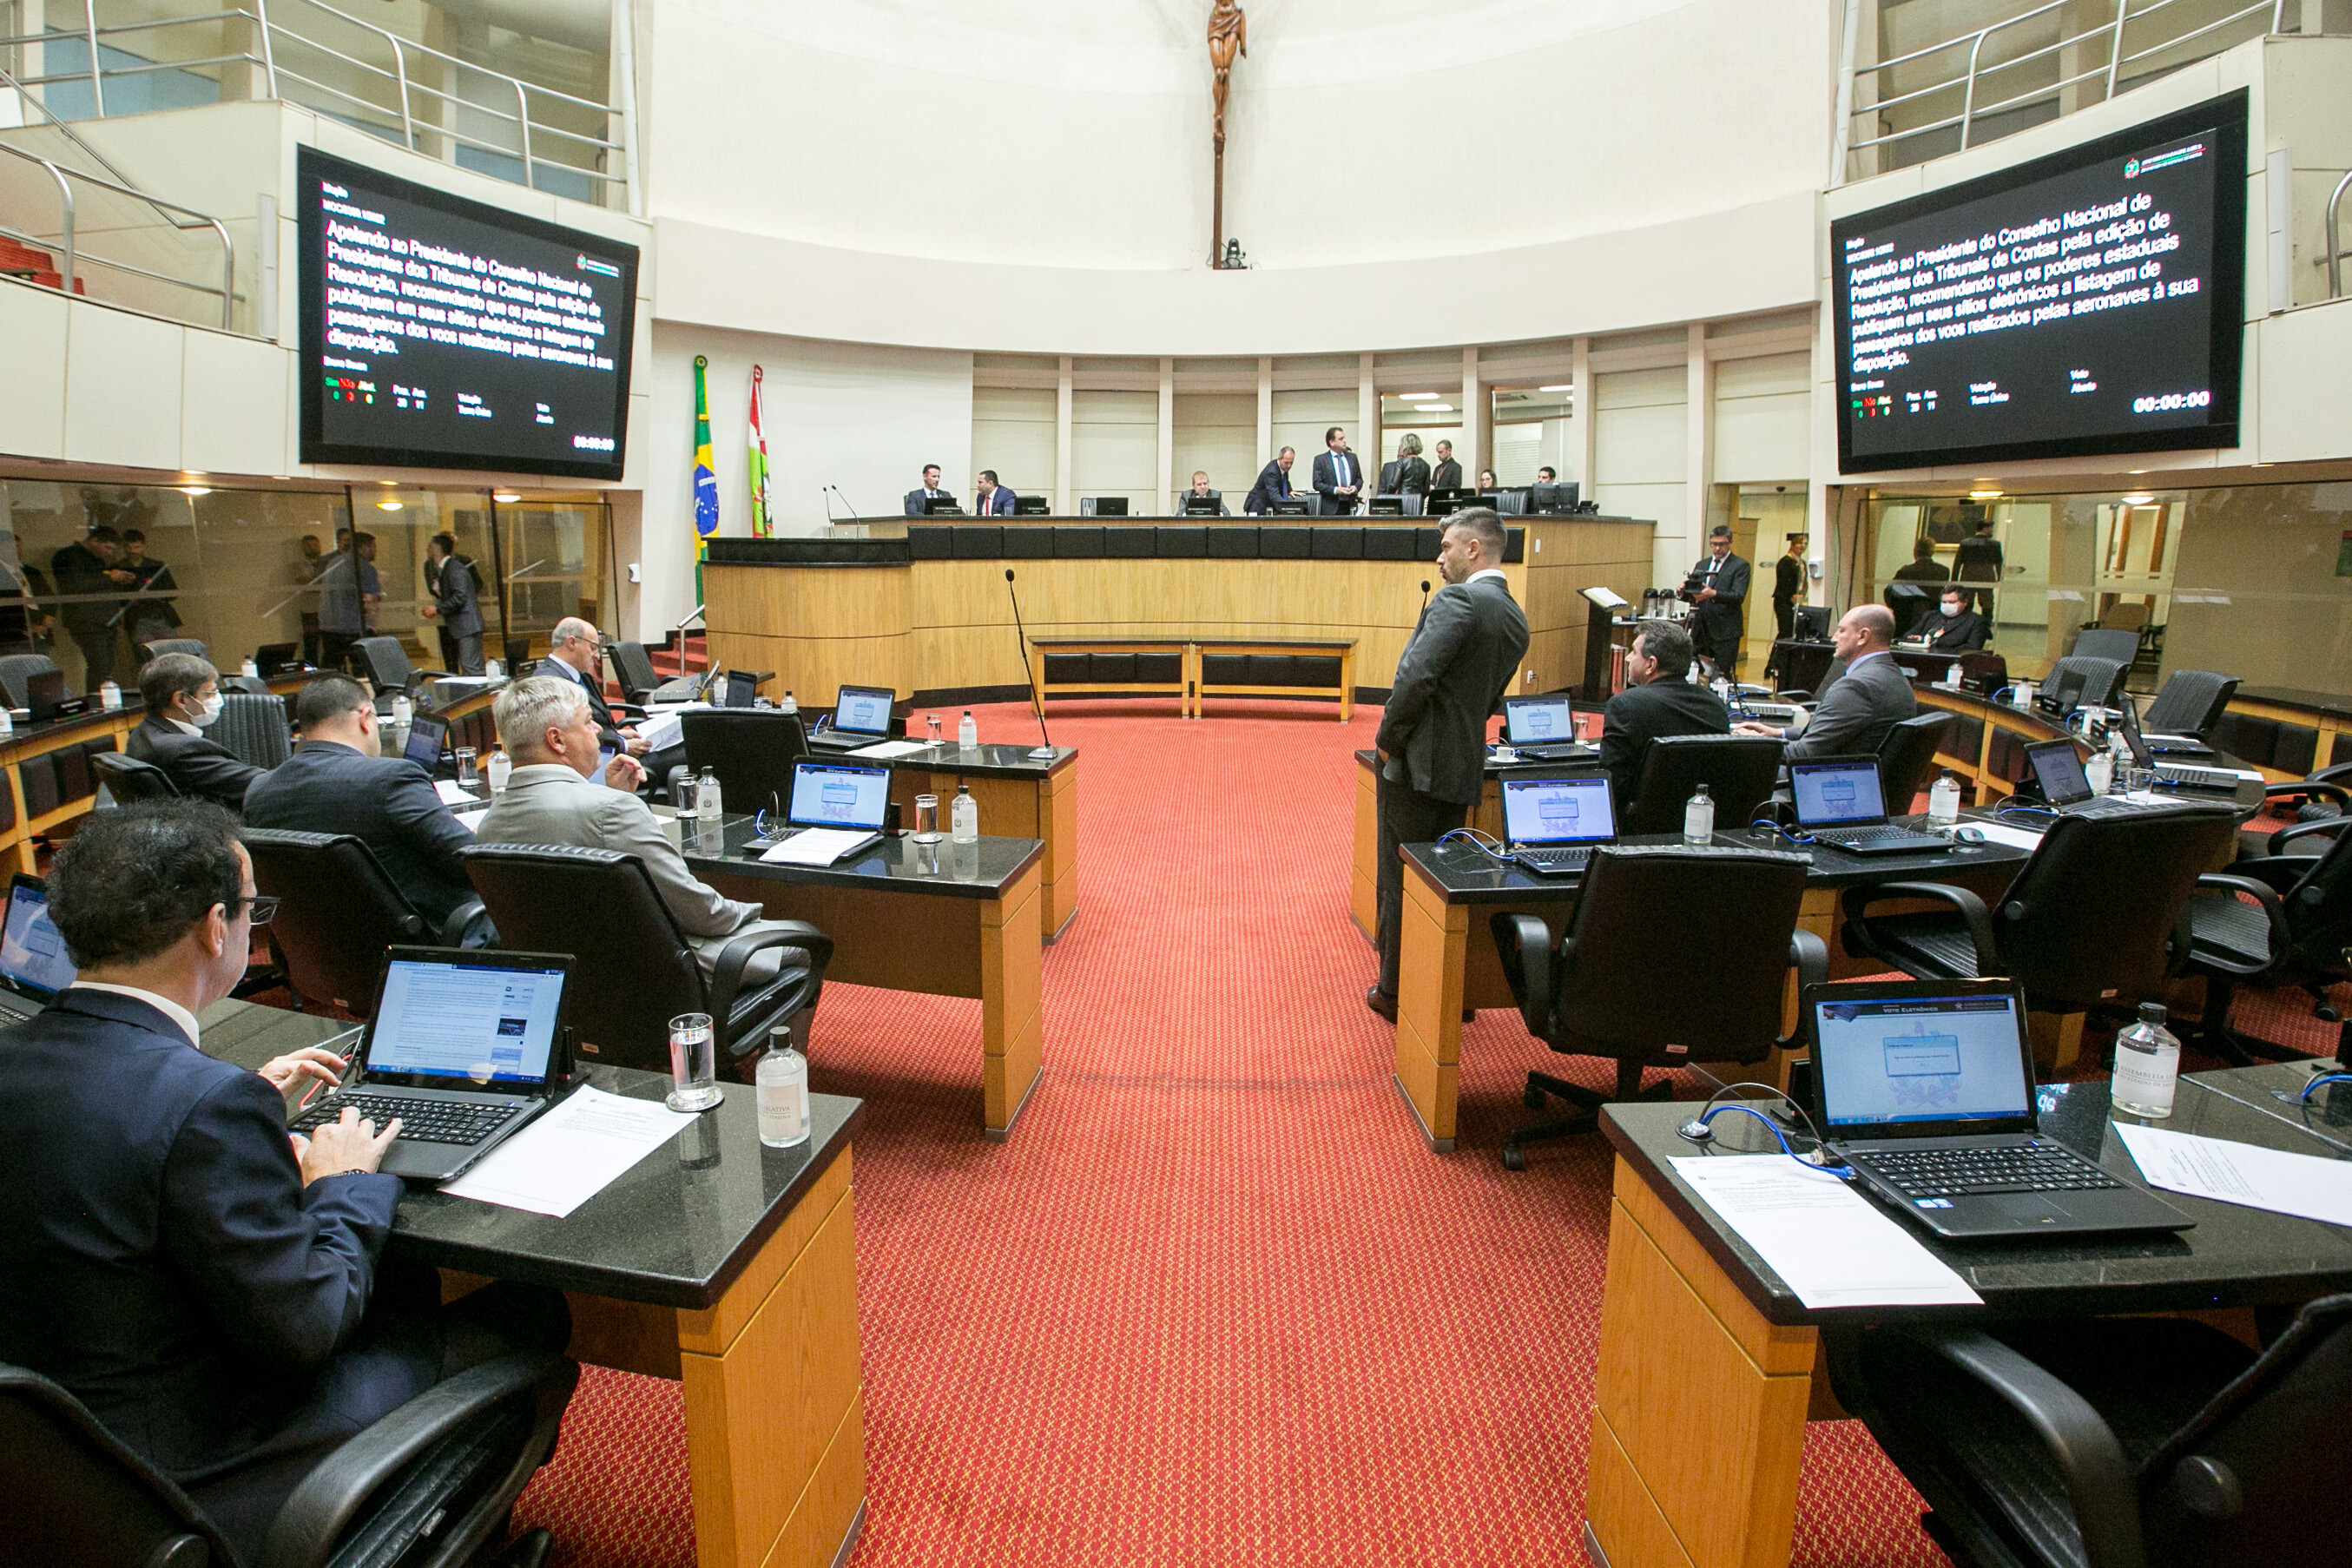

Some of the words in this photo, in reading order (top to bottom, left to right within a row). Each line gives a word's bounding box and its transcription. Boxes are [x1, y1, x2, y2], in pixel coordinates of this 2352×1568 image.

[1849, 276, 1912, 306] Presidentes
[1912, 271, 1934, 287] dos
[1934, 255, 1991, 282] Tribunais
[1991, 251, 2009, 269] de
[2010, 240, 2059, 264] Contas
[2060, 231, 2092, 256] pela
[2093, 218, 2145, 244] edição
[2147, 211, 2171, 231] de
[1899, 256, 1914, 272] ao
[1914, 239, 1978, 267] Presidente
[1979, 234, 1997, 252] do
[1998, 218, 2061, 247] Conselho
[2062, 196, 2128, 230] Nacional
[2130, 193, 2151, 213] de
[1851, 295, 1908, 320] Resolução,
[1908, 274, 1996, 307] recomendando
[1996, 270, 2022, 291] que
[2023, 266, 2042, 282] os
[2044, 253, 2102, 281] poderes
[2103, 233, 2180, 265] estaduais
[1851, 315, 1904, 340] publiquem
[1905, 312, 1925, 327] em
[1925, 305, 1954, 323] seus
[1954, 298, 1987, 317] sítios
[1988, 283, 2059, 310] eletrônicos
[2073, 267, 2137, 293] listagem
[2138, 260, 2161, 280] de
[1851, 333, 1914, 359] passageiros
[1914, 327, 1937, 344] dos
[1937, 322, 1967, 339] voos
[1967, 310, 2031, 334] realizados
[2032, 302, 2071, 326] pelas
[2072, 287, 2151, 315] aeronaves
[2167, 277, 2199, 297] sua
[1852, 351, 1909, 373] disposição.
[2134, 391, 2210, 414] 00:00:00
